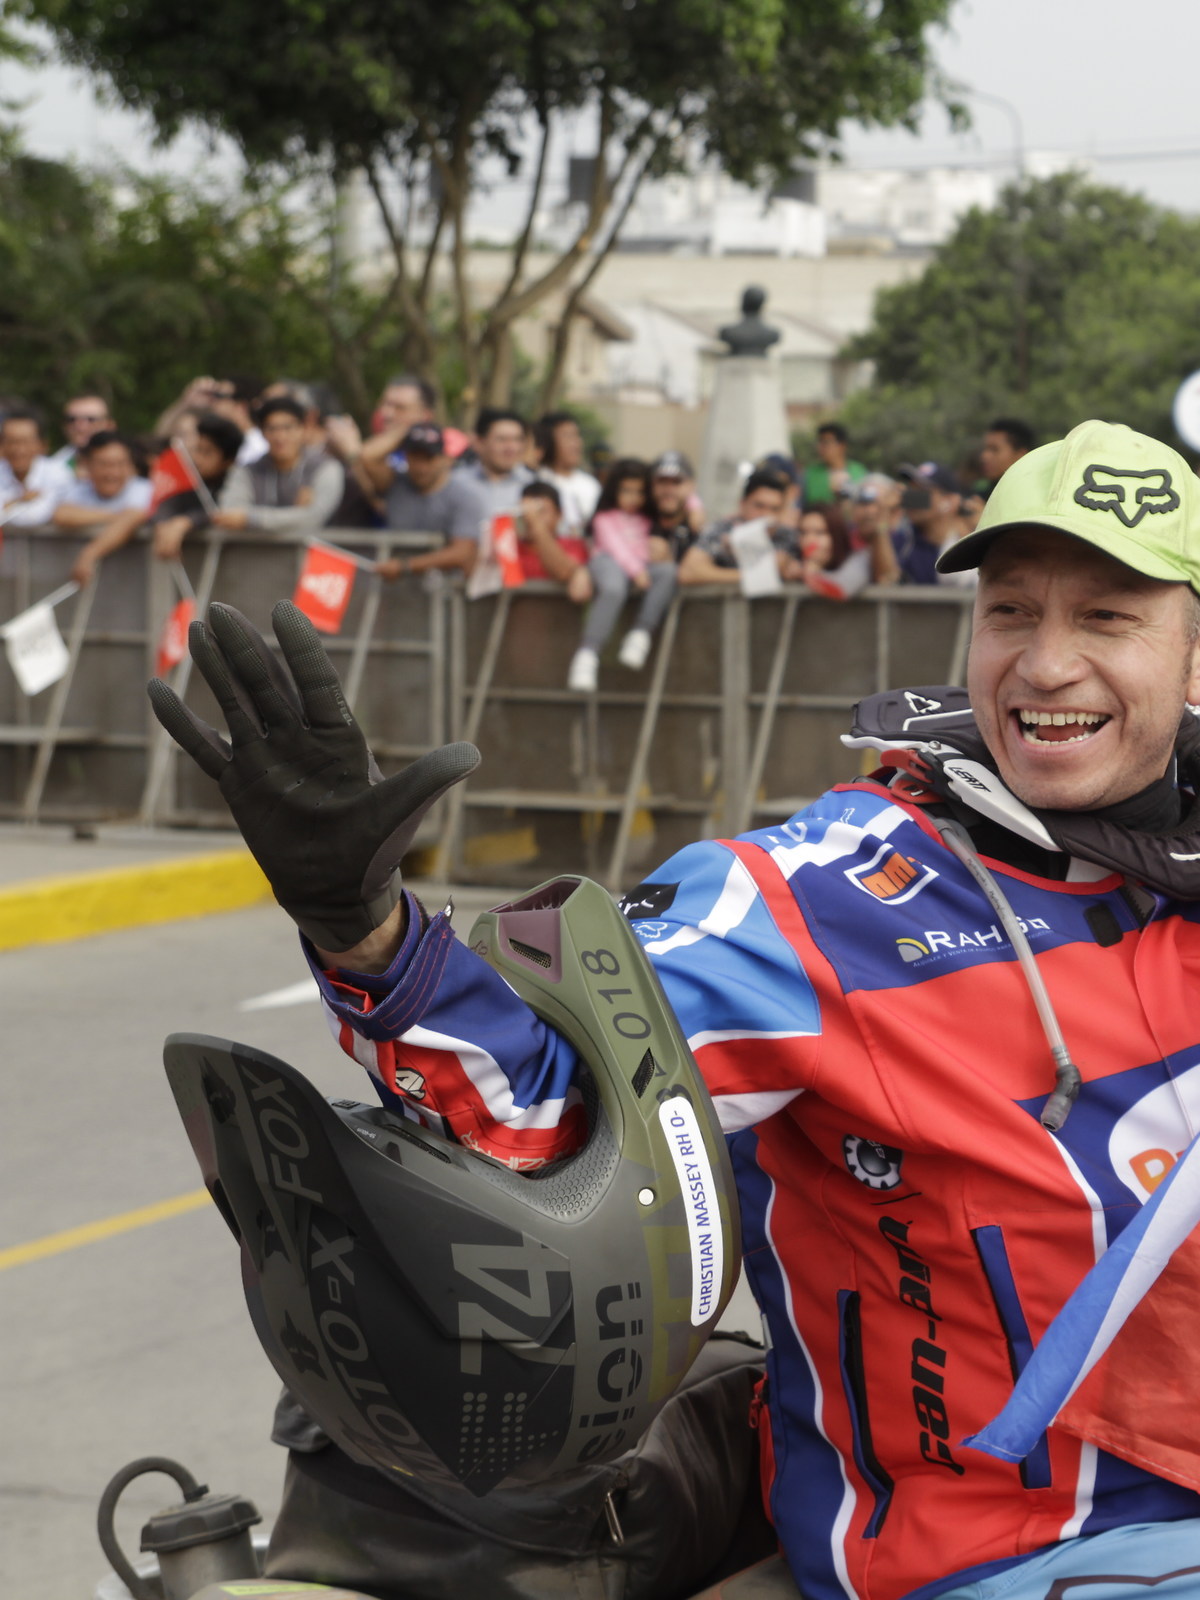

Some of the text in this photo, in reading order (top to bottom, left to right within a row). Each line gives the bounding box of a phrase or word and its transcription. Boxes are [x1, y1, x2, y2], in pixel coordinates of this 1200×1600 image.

[581, 948, 651, 1040] 018
[241, 1065, 323, 1203] FOX
[675, 1132, 695, 1156] RH
[684, 1162, 711, 1227] MASSEY
[698, 1233, 714, 1316] CHRISTIAN
